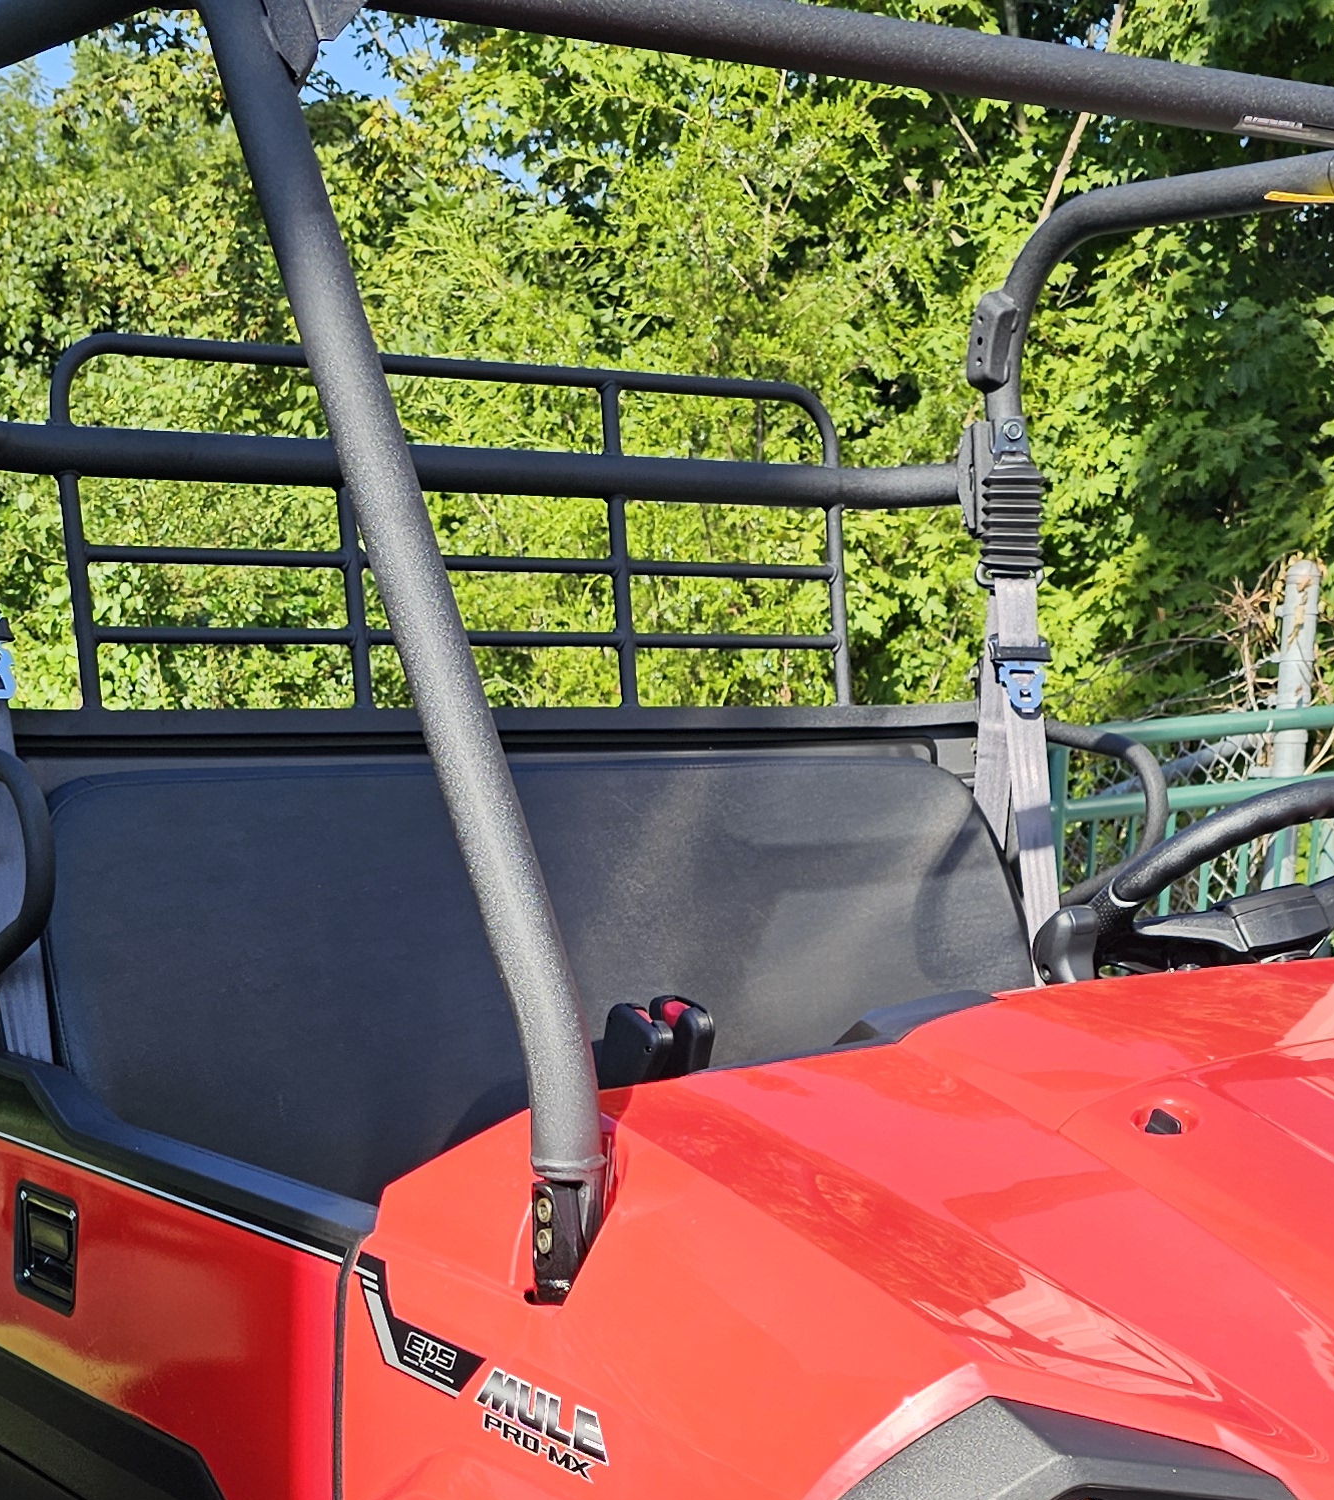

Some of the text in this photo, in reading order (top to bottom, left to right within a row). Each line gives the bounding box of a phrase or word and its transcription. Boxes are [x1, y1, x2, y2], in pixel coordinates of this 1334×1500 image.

[404, 1331, 457, 1371] EPS
[474, 1367, 609, 1466] MULE
[482, 1411, 594, 1484] PRO-MX
